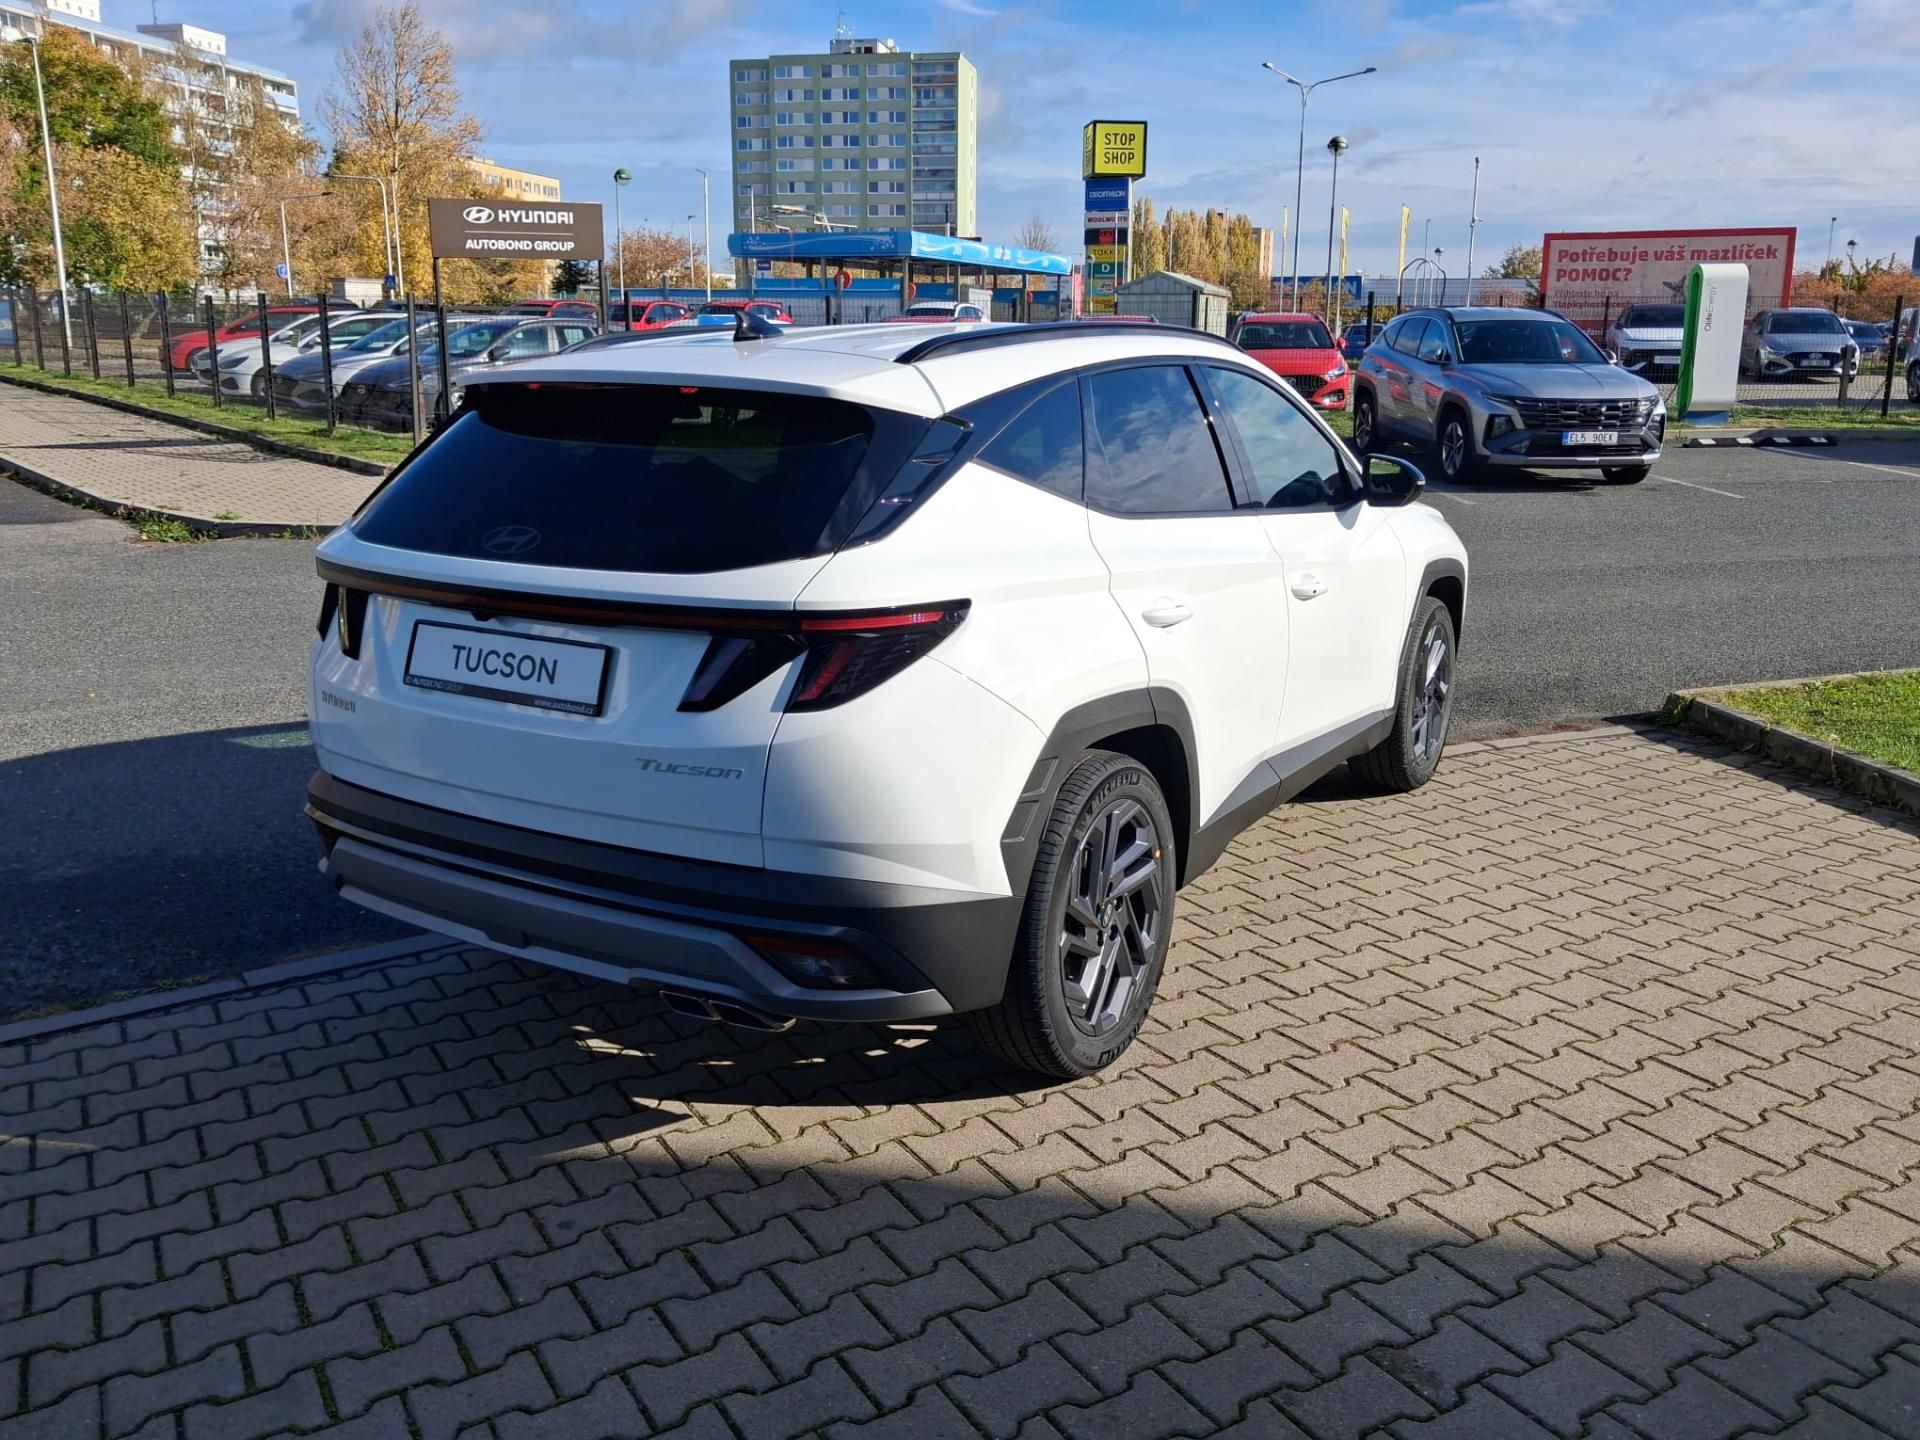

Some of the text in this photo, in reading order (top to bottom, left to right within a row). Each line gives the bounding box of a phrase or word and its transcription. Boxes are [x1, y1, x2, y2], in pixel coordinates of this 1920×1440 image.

[1104, 132, 1136, 146] STOP
[1103, 151, 1135, 165] SHOP
[498, 209, 574, 225] HYUNDAI
[465, 239, 575, 252] AUTOBOND GROUP
[1558, 244, 1778, 265] Potřebuje váš mazlíček
[1556, 267, 1633, 282] POMOC?
[452, 644, 558, 685] TUCSON
